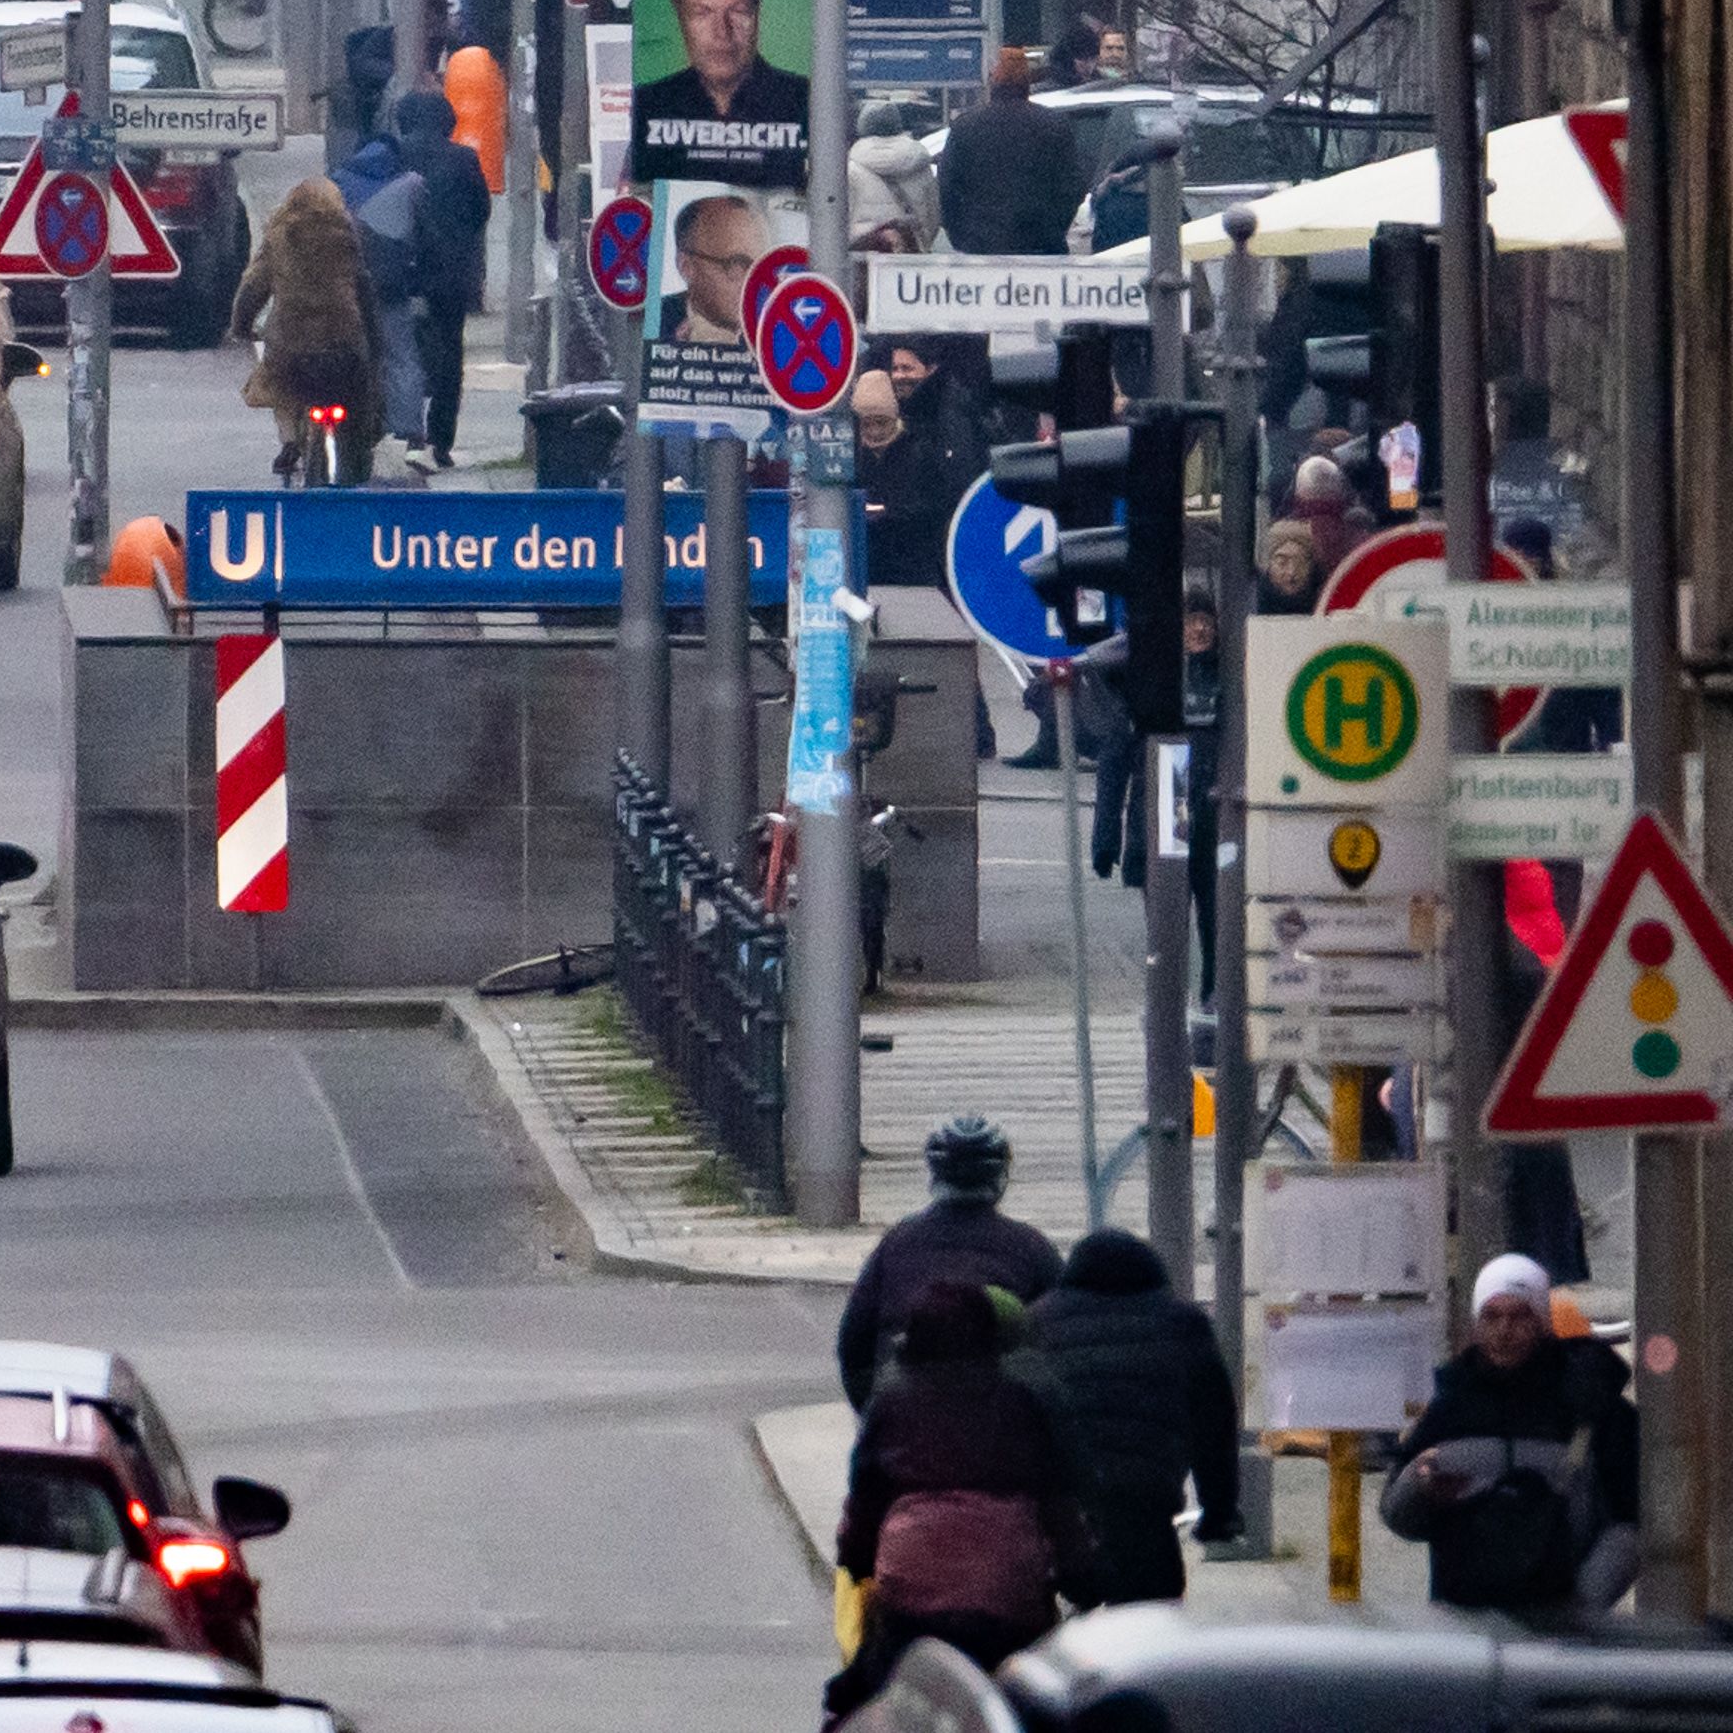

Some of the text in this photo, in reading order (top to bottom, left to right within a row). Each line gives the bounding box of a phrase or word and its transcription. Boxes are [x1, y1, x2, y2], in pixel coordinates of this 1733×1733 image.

[112, 102, 268, 137] Behrenstraße
[647, 119, 808, 148] ZUVERSICHT.
[897, 270, 1144, 307] Unter den Linde
[651, 343, 678, 360] Für
[681, 345, 709, 362] ein
[650, 365, 745, 384] auf das wir
[648, 385, 692, 403] stolz
[209, 510, 265, 580] U
[372, 525, 497, 568] Unter
[514, 523, 596, 568] den
[1324, 675, 1385, 750] H
